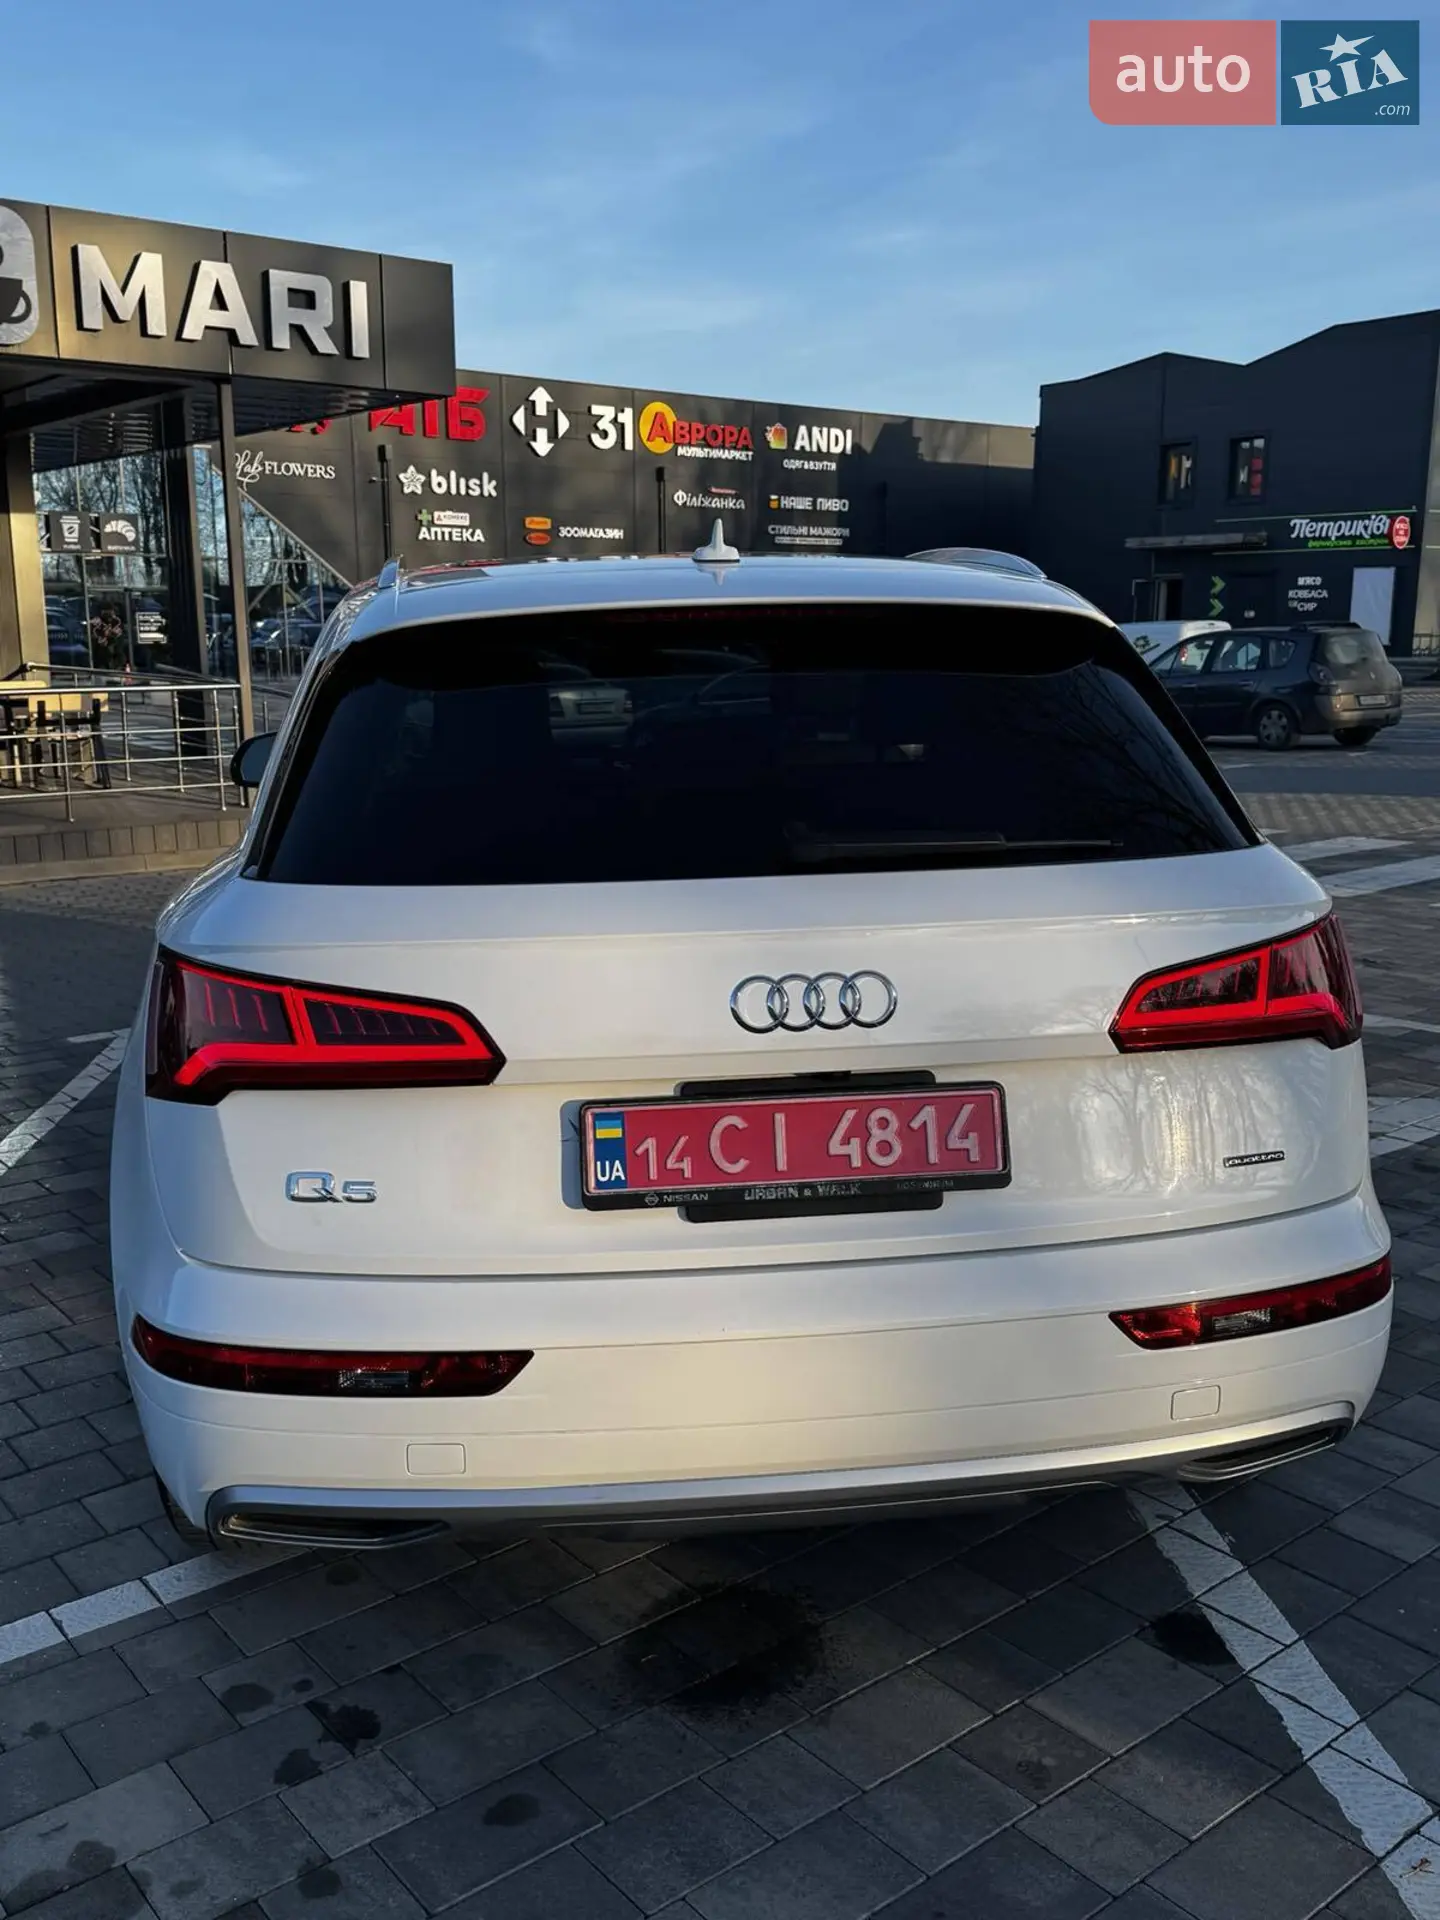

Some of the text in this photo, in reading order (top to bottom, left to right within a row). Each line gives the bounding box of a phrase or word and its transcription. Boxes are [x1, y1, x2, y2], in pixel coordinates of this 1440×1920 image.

[74, 243, 371, 359] MARI
[588, 404, 634, 451] 31
[794, 424, 853, 455] ANDI
[676, 446, 754, 462] МУЛЬТИМАРКЕТ
[264, 461, 336, 480] FLOWERS
[430, 467, 498, 498] blisk
[673, 488, 746, 510] Філіжанка
[780, 496, 850, 512] НАШЕ ПИВО
[417, 526, 486, 543] АПТЕКА
[558, 526, 625, 540] ЗООМАГАЗИН
[634, 1135, 692, 1181] 14
[827, 1103, 981, 1169] 4814
[1226, 1151, 1284, 1167] quattro
[596, 1159, 626, 1182] UA
[284, 1170, 378, 1203] Q5
[662, 1191, 709, 1203] NISSAN
